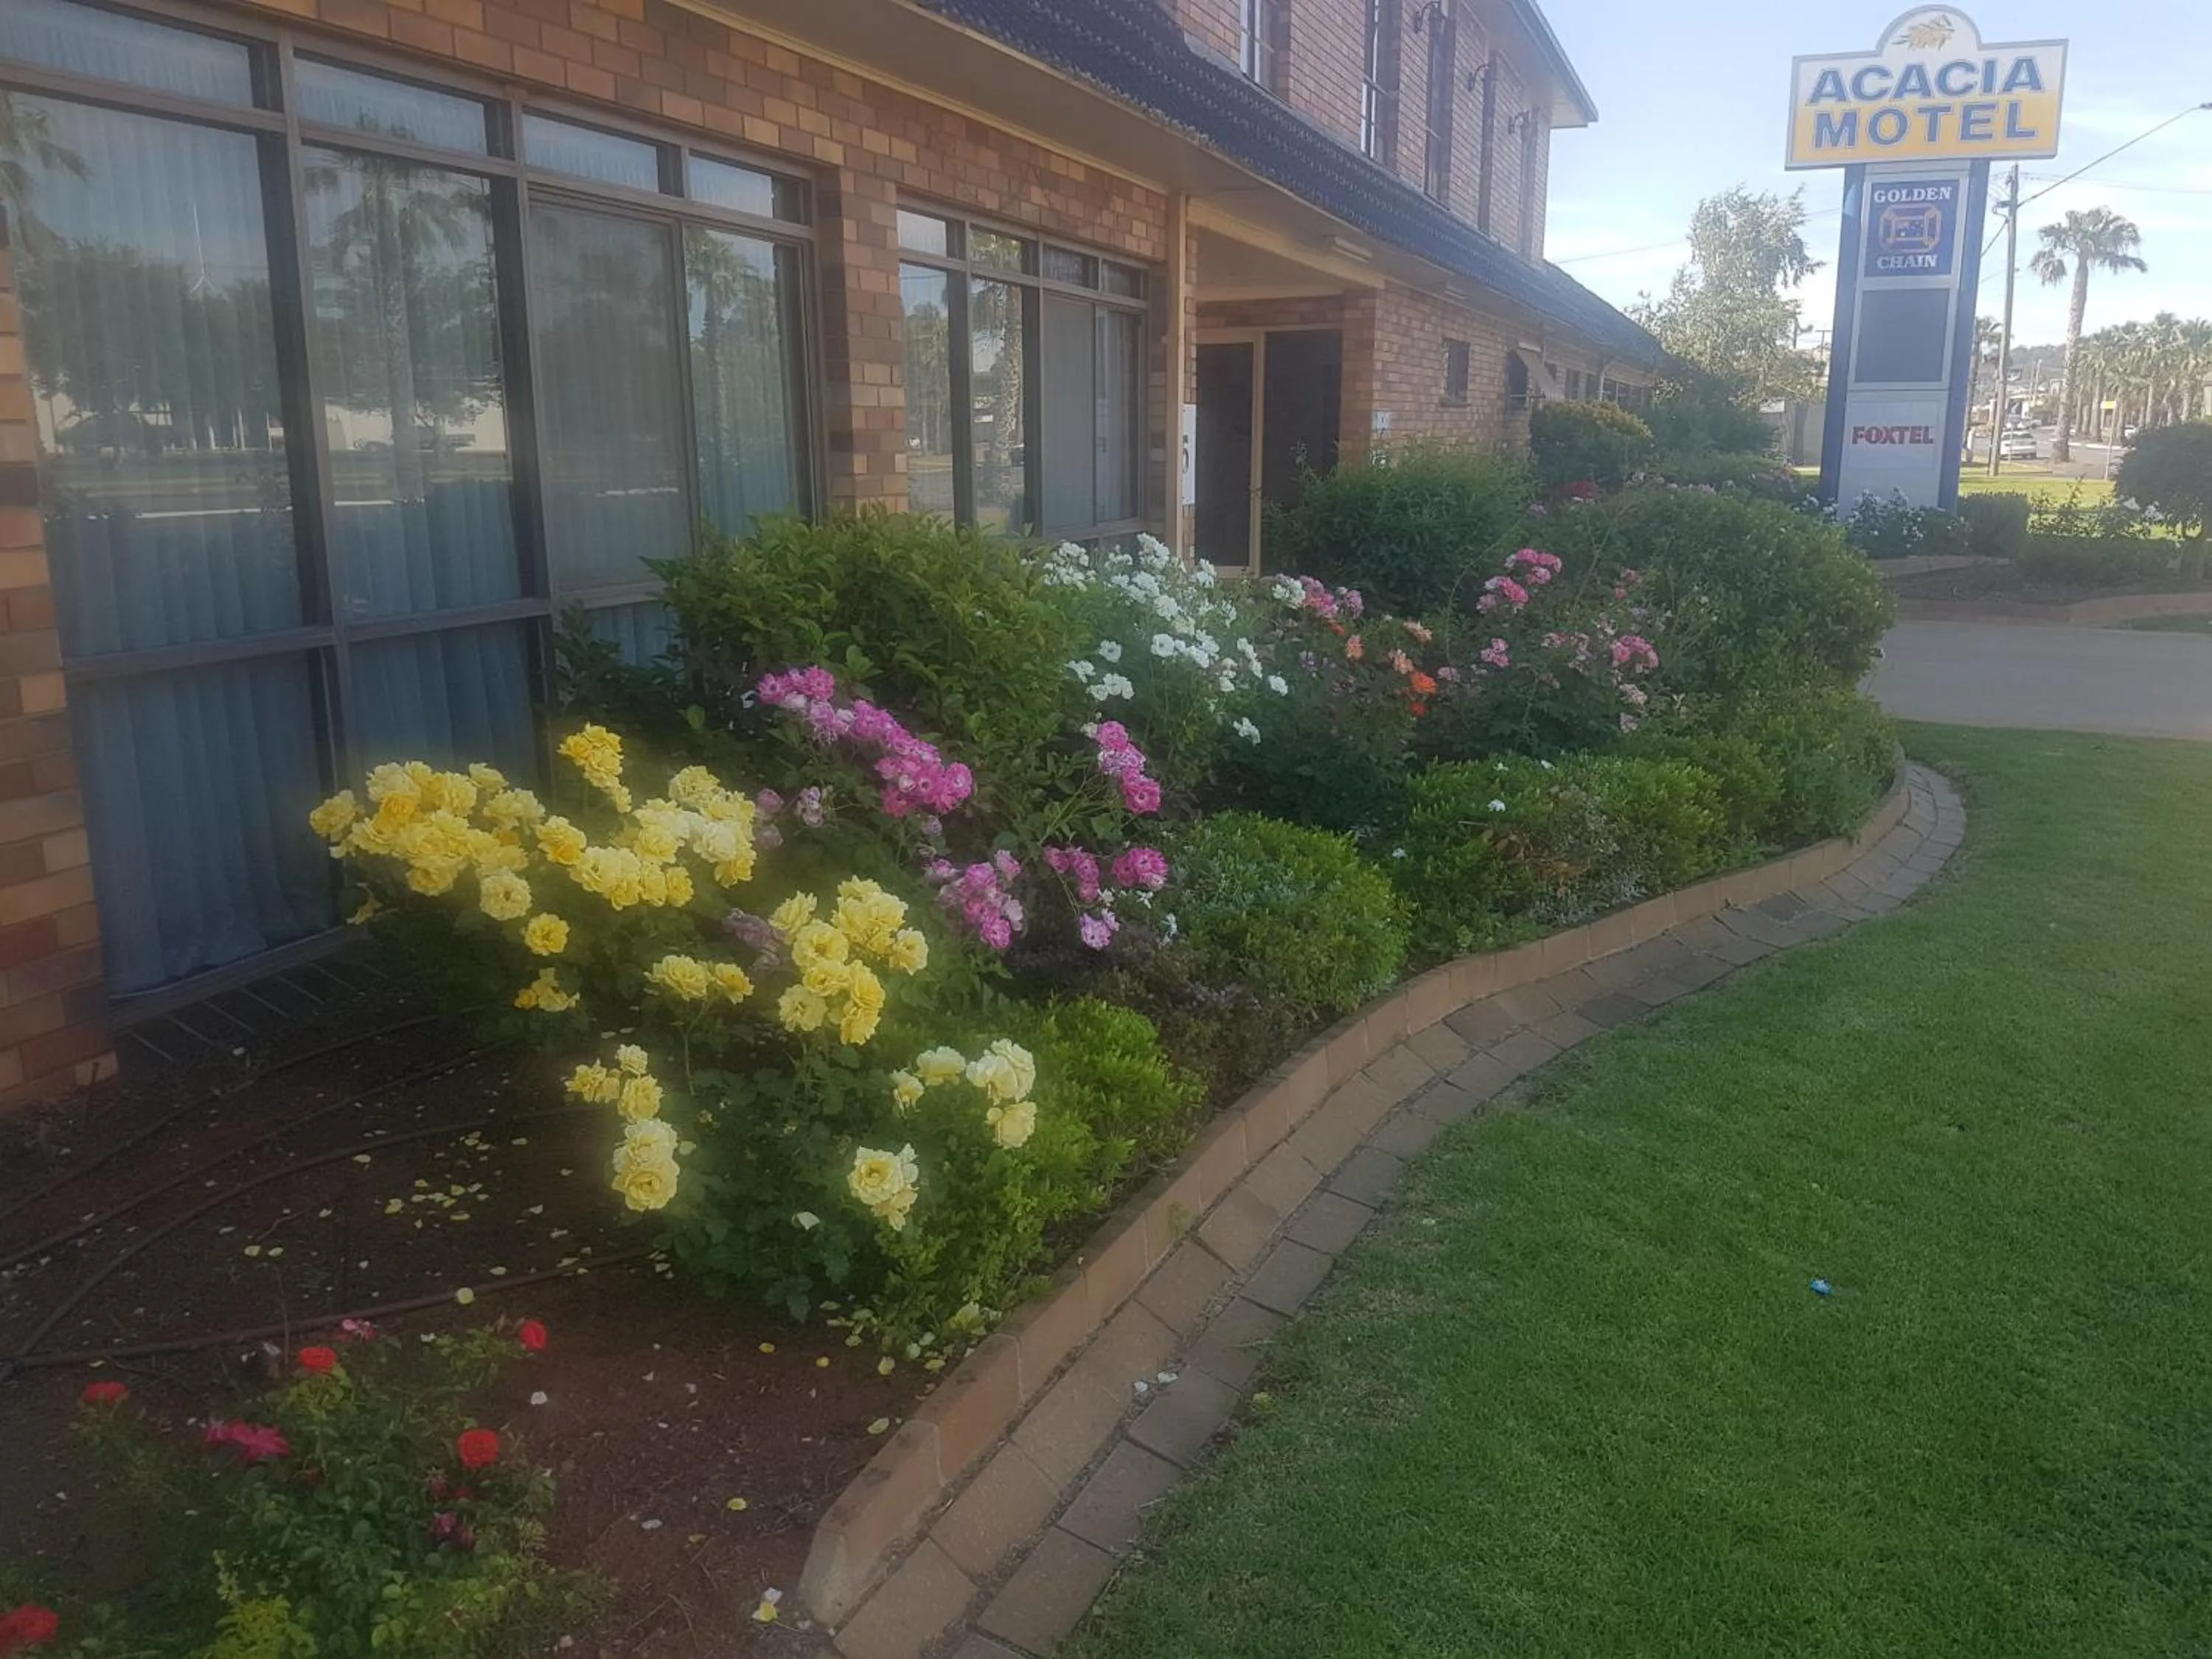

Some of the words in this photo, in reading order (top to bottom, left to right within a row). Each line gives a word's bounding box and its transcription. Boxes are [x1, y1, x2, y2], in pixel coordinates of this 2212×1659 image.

[1807, 57, 2042, 104] ACACIA
[1815, 101, 2037, 147] MOTEL
[1874, 187, 1952, 203] GOLDEN
[1877, 254, 1937, 269] CHAIN
[1851, 425, 1934, 444] FOXTEL
